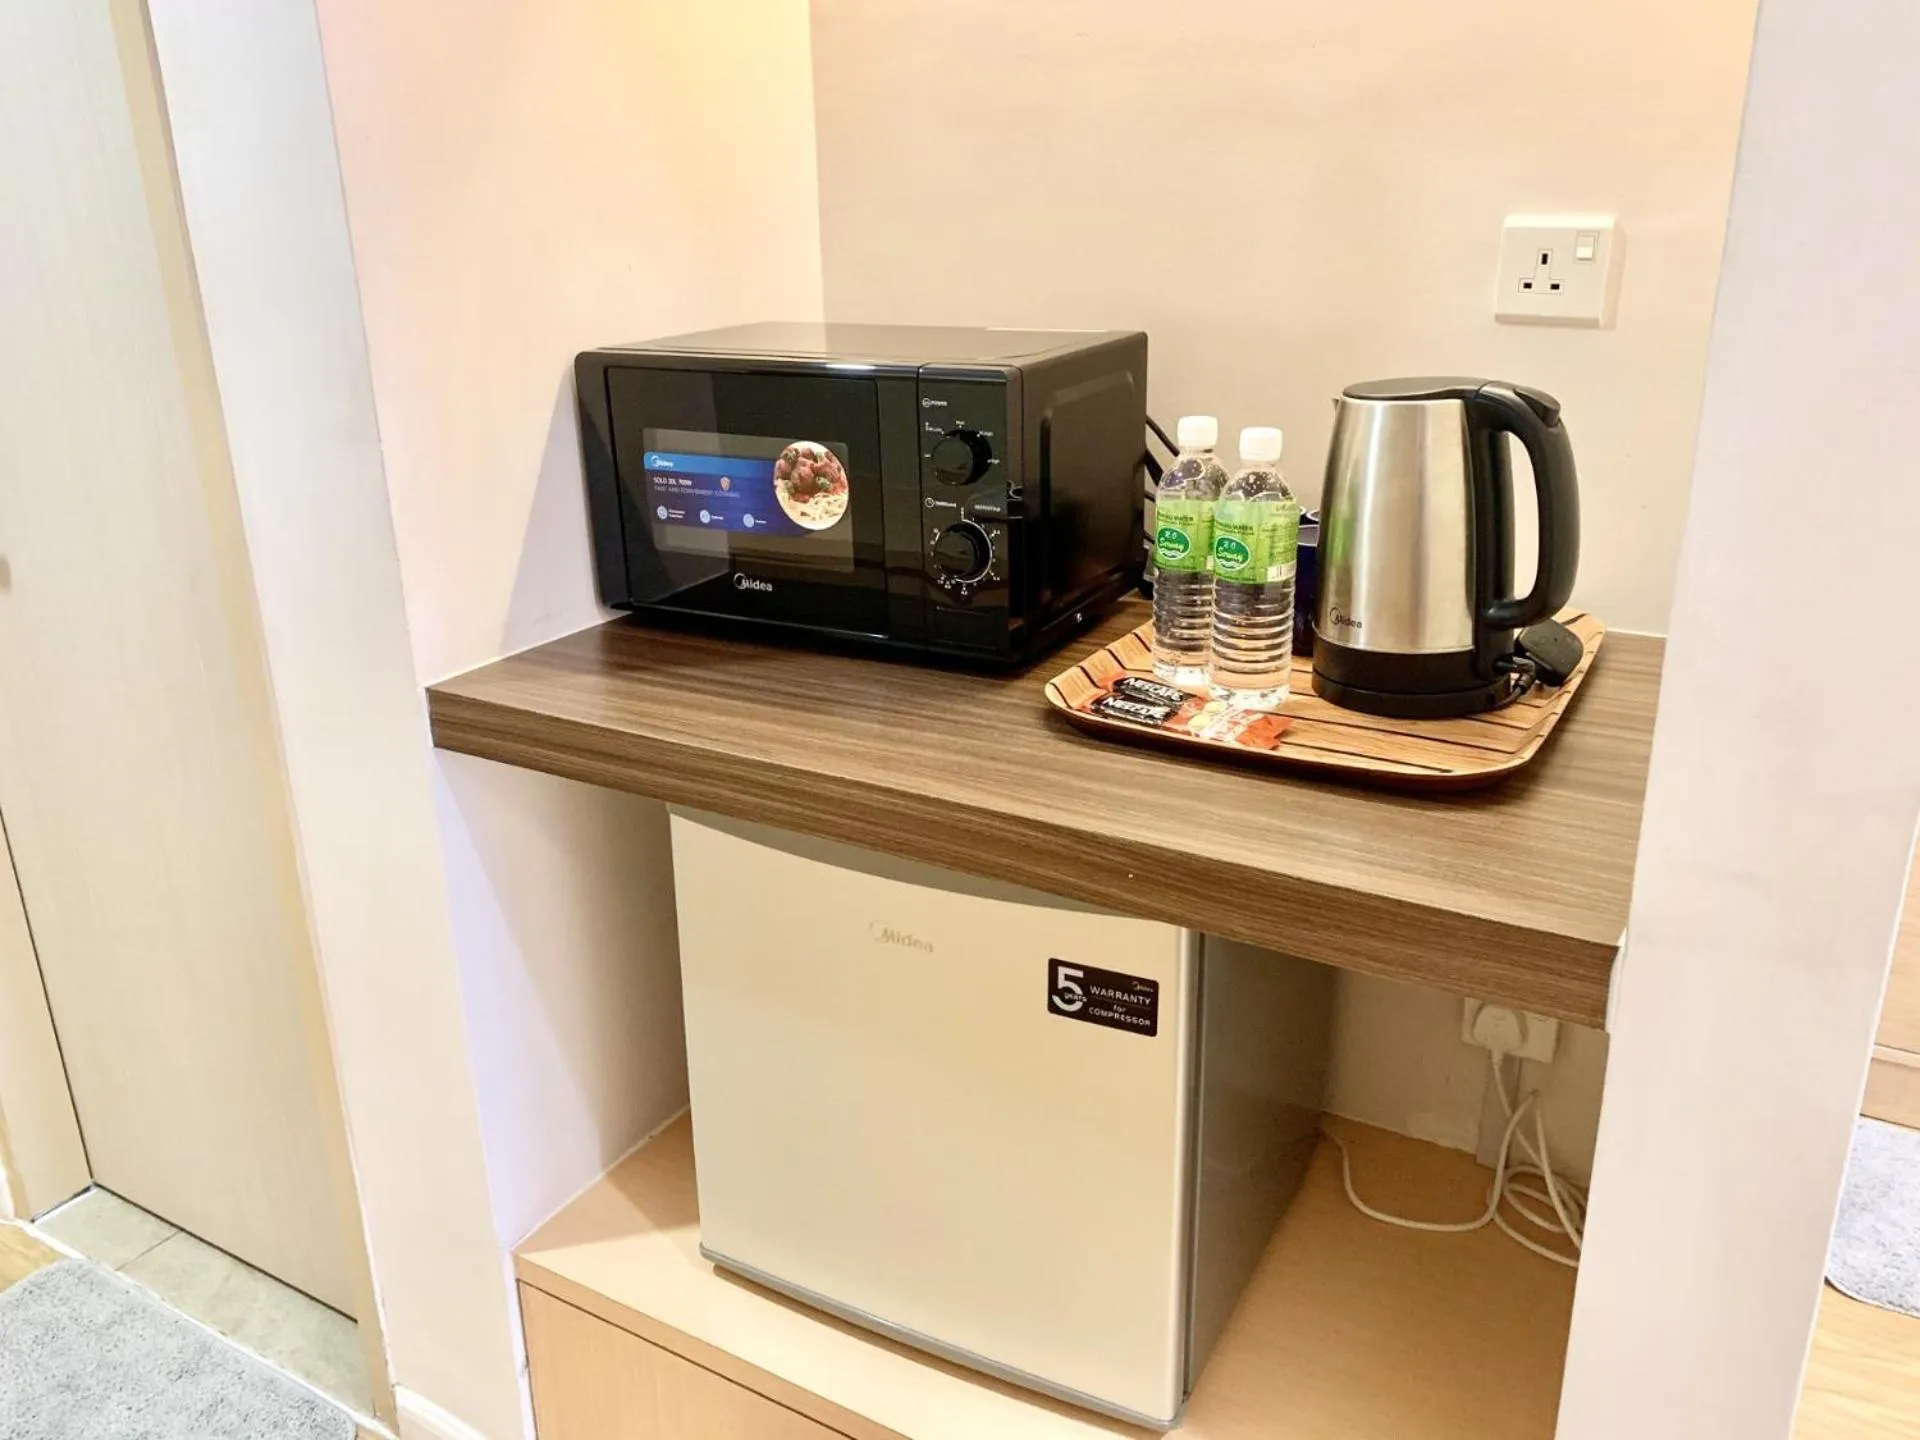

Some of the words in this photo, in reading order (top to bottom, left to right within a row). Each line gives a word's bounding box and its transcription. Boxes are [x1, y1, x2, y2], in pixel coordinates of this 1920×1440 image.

[733, 572, 773, 592] Midea
[1330, 606, 1363, 629] Midea
[1052, 966, 1084, 1012] 5
[1089, 985, 1151, 1006] WARRANTY
[1088, 1007, 1151, 1027] COMPRESSOR
[1113, 1004, 1126, 1013] for
